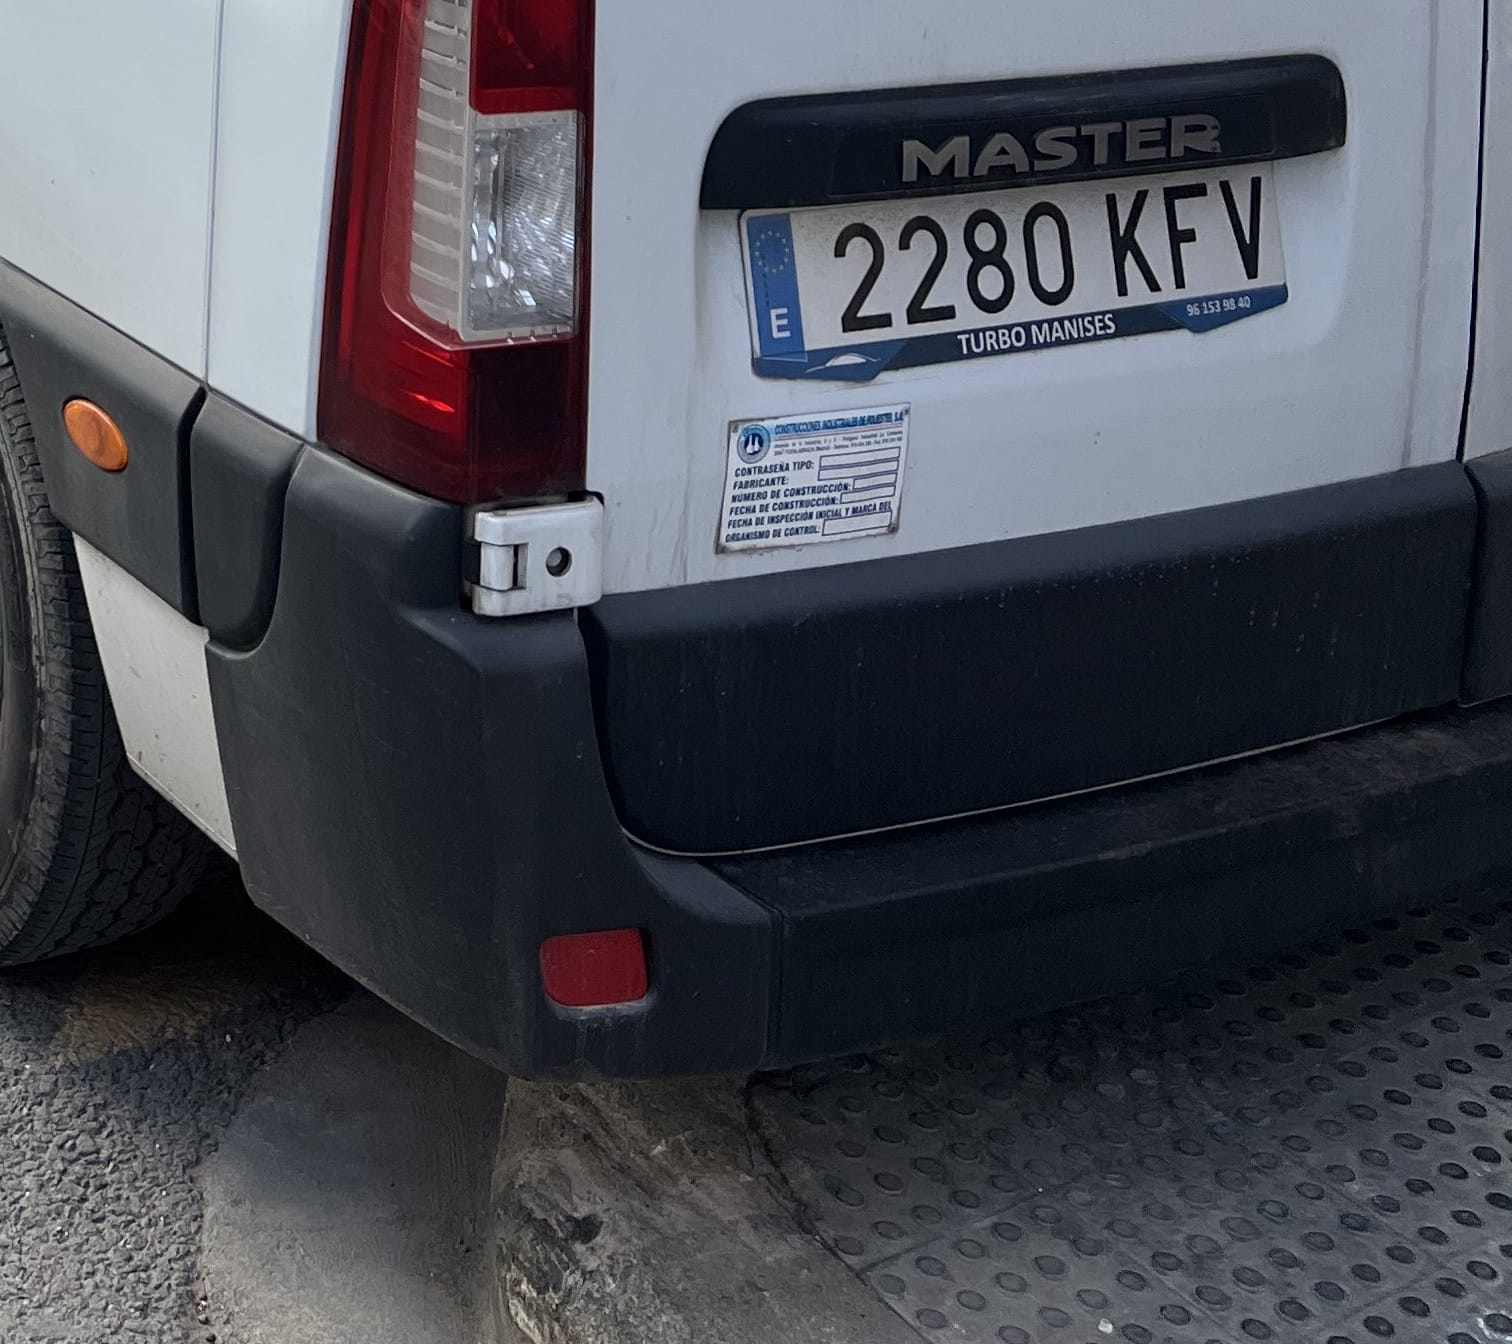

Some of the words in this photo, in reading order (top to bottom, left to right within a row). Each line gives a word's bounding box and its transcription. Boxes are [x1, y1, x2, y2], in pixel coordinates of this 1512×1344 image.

[901, 114, 1222, 183] MASTER
[834, 201, 1075, 334] 2280
[1105, 175, 1263, 298] KFV
[1186, 303, 1200, 316] 96
[1202, 300, 1221, 314] 153
[770, 307, 791, 339] E
[957, 326, 1026, 356] TURBO
[1030, 314, 1117, 348] MANISES
[792, 459, 814, 470] TIPO:
[733, 476, 789, 490] FABRICANTE:
[770, 488, 781, 500] DE
[728, 517, 753, 529] FECHA
[755, 514, 765, 526] DE
[844, 506, 850, 516] Y
[729, 505, 756, 517] FECHA
[759, 503, 770, 514] DE
[772, 526, 782, 538] DE
